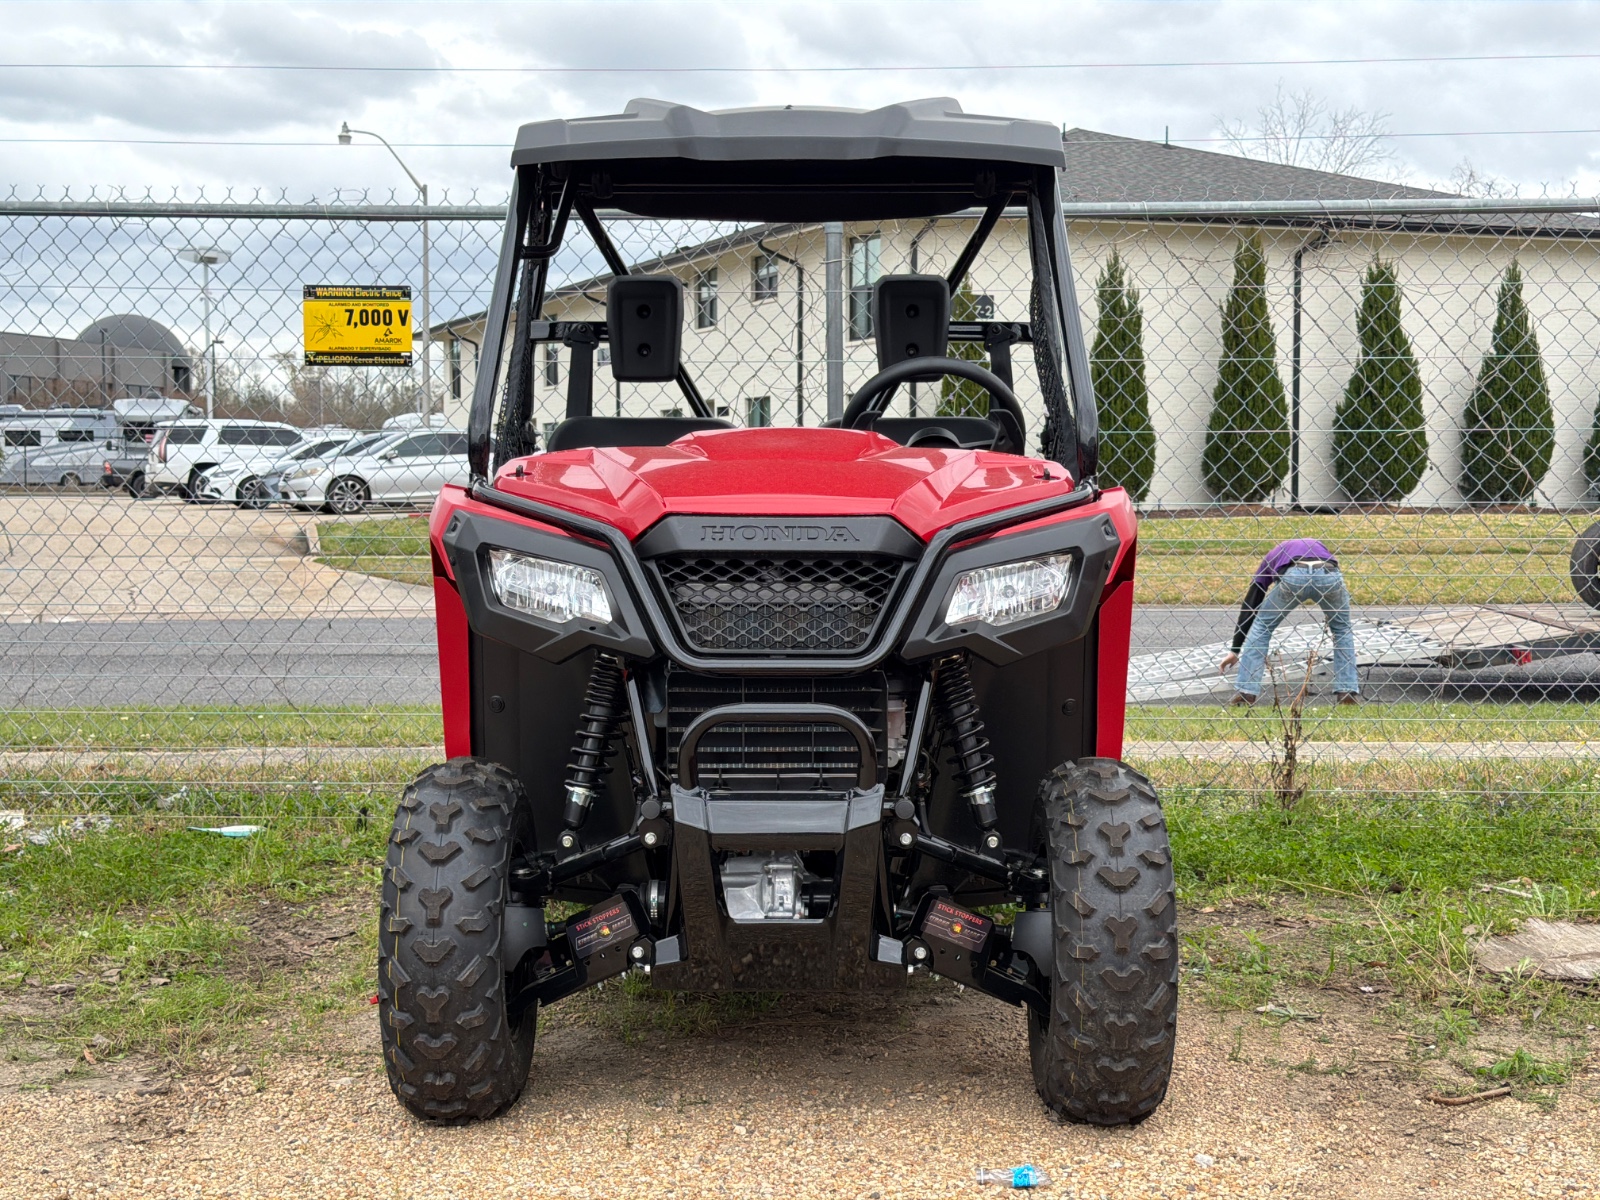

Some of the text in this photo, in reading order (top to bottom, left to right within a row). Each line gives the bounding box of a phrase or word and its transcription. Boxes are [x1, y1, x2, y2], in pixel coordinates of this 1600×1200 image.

[316, 287, 402, 297] WARNING! Electric Fence
[345, 309, 409, 328] 7,000 V
[353, 356, 373, 364] Cerca
[700, 525, 860, 542] HONDA
[937, 903, 984, 926] STICK STOPPERS
